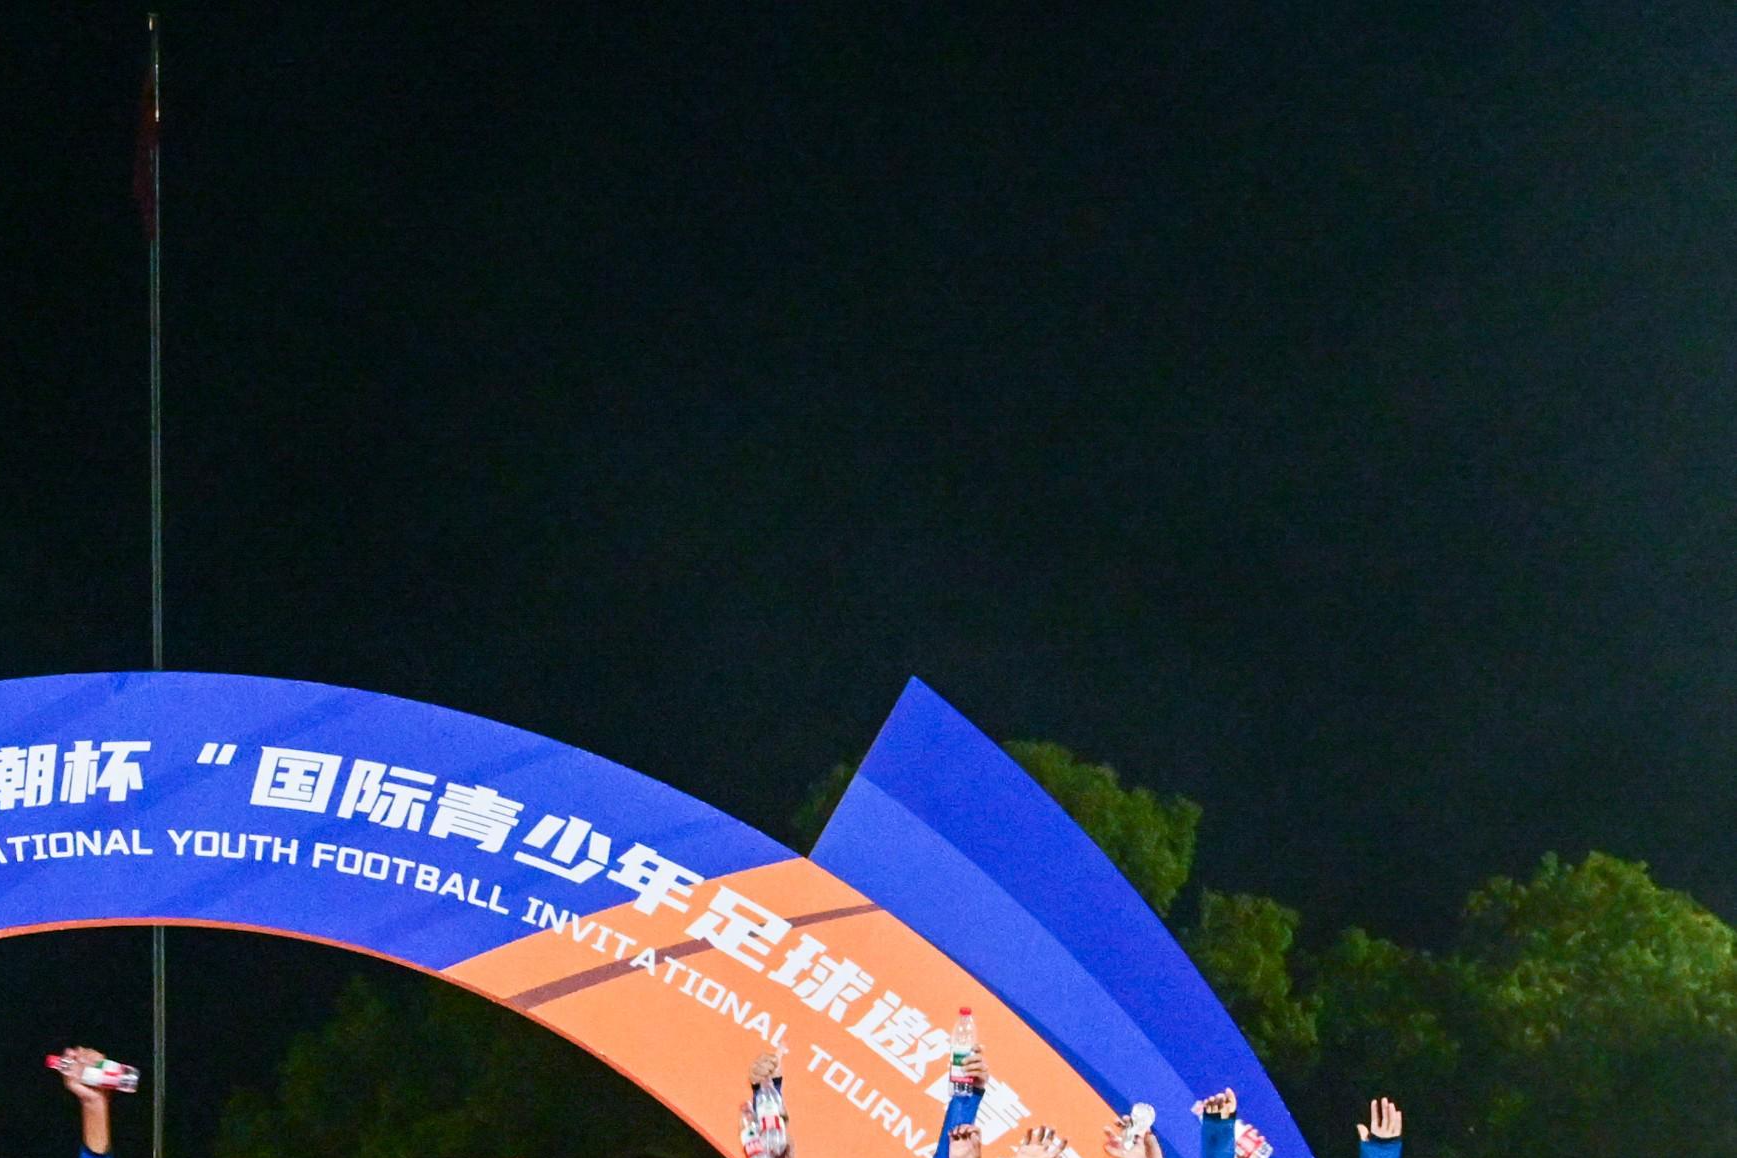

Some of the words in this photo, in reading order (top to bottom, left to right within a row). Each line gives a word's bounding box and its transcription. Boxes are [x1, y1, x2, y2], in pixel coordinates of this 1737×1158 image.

[167, 829, 298, 865] YOUTH
[312, 843, 509, 915] FOOTBALL
[522, 897, 790, 1055] INVITATIONAL
